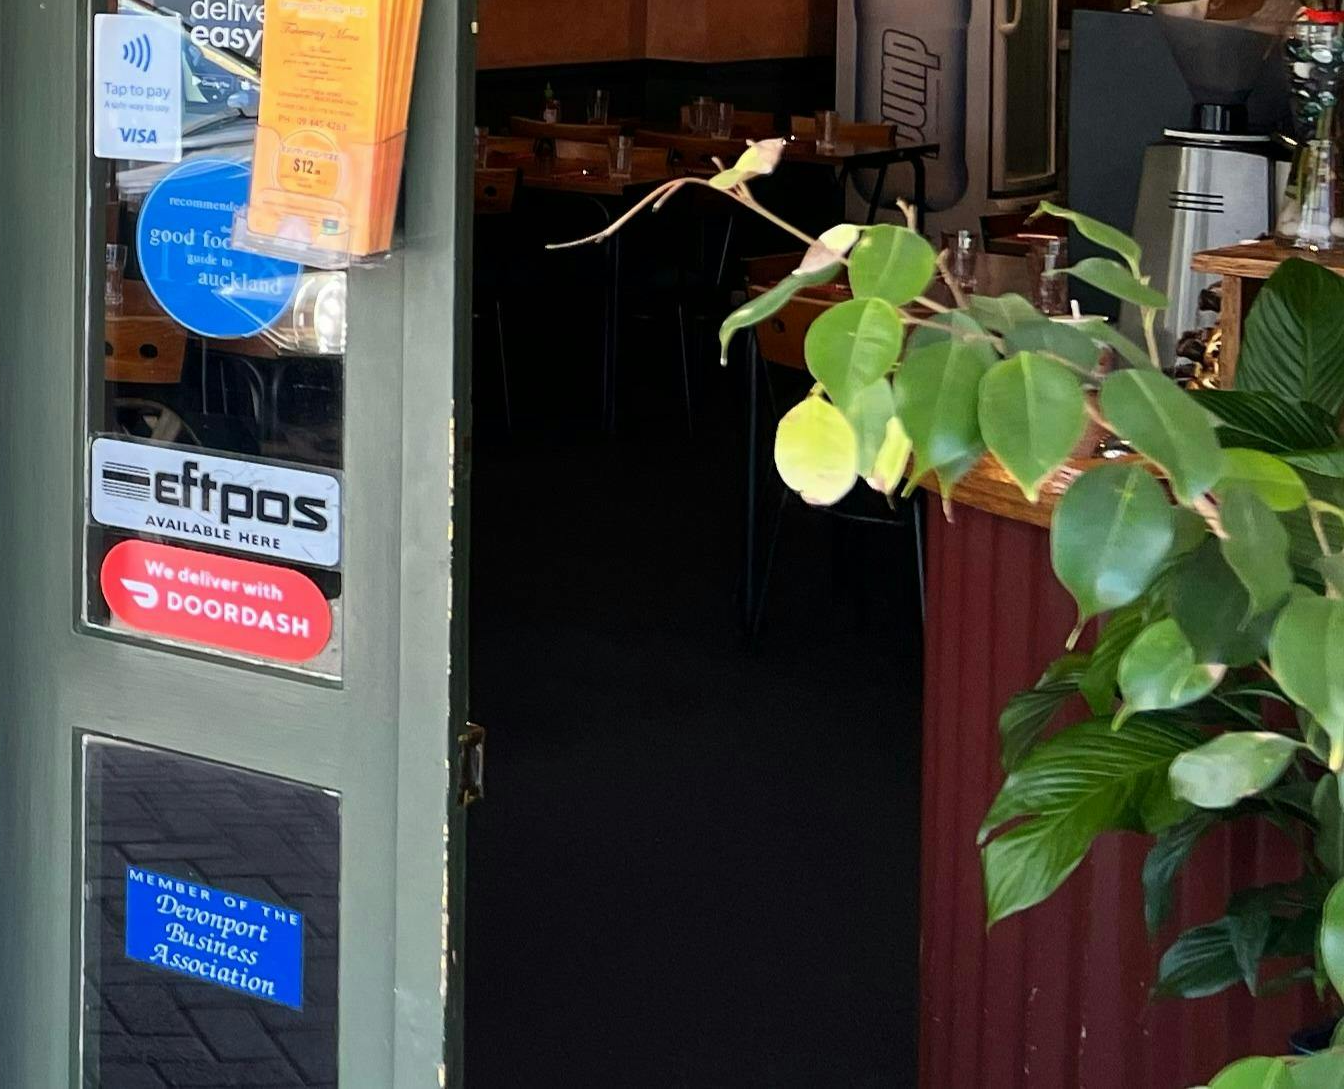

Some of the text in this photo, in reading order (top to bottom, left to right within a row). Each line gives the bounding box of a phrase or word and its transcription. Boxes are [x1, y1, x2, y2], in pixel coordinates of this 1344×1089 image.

[191, 25, 263, 57] easy
[103, 82, 171, 101] Tap to pay
[118, 127, 158, 144] VISA
[149, 227, 195, 247] good
[186, 252, 233, 267] guide to
[197, 271, 281, 296] auckland
[154, 460, 329, 533] eftpos
[145, 514, 282, 550] AVAILABLE HERE
[145, 558, 284, 602] We deliver with
[167, 591, 310, 639] DOORDASH
[129, 869, 300, 926] MEMBER OF THE
[156, 894, 269, 942] Devonport
[165, 922, 260, 966] Business
[149, 944, 276, 997] Association
